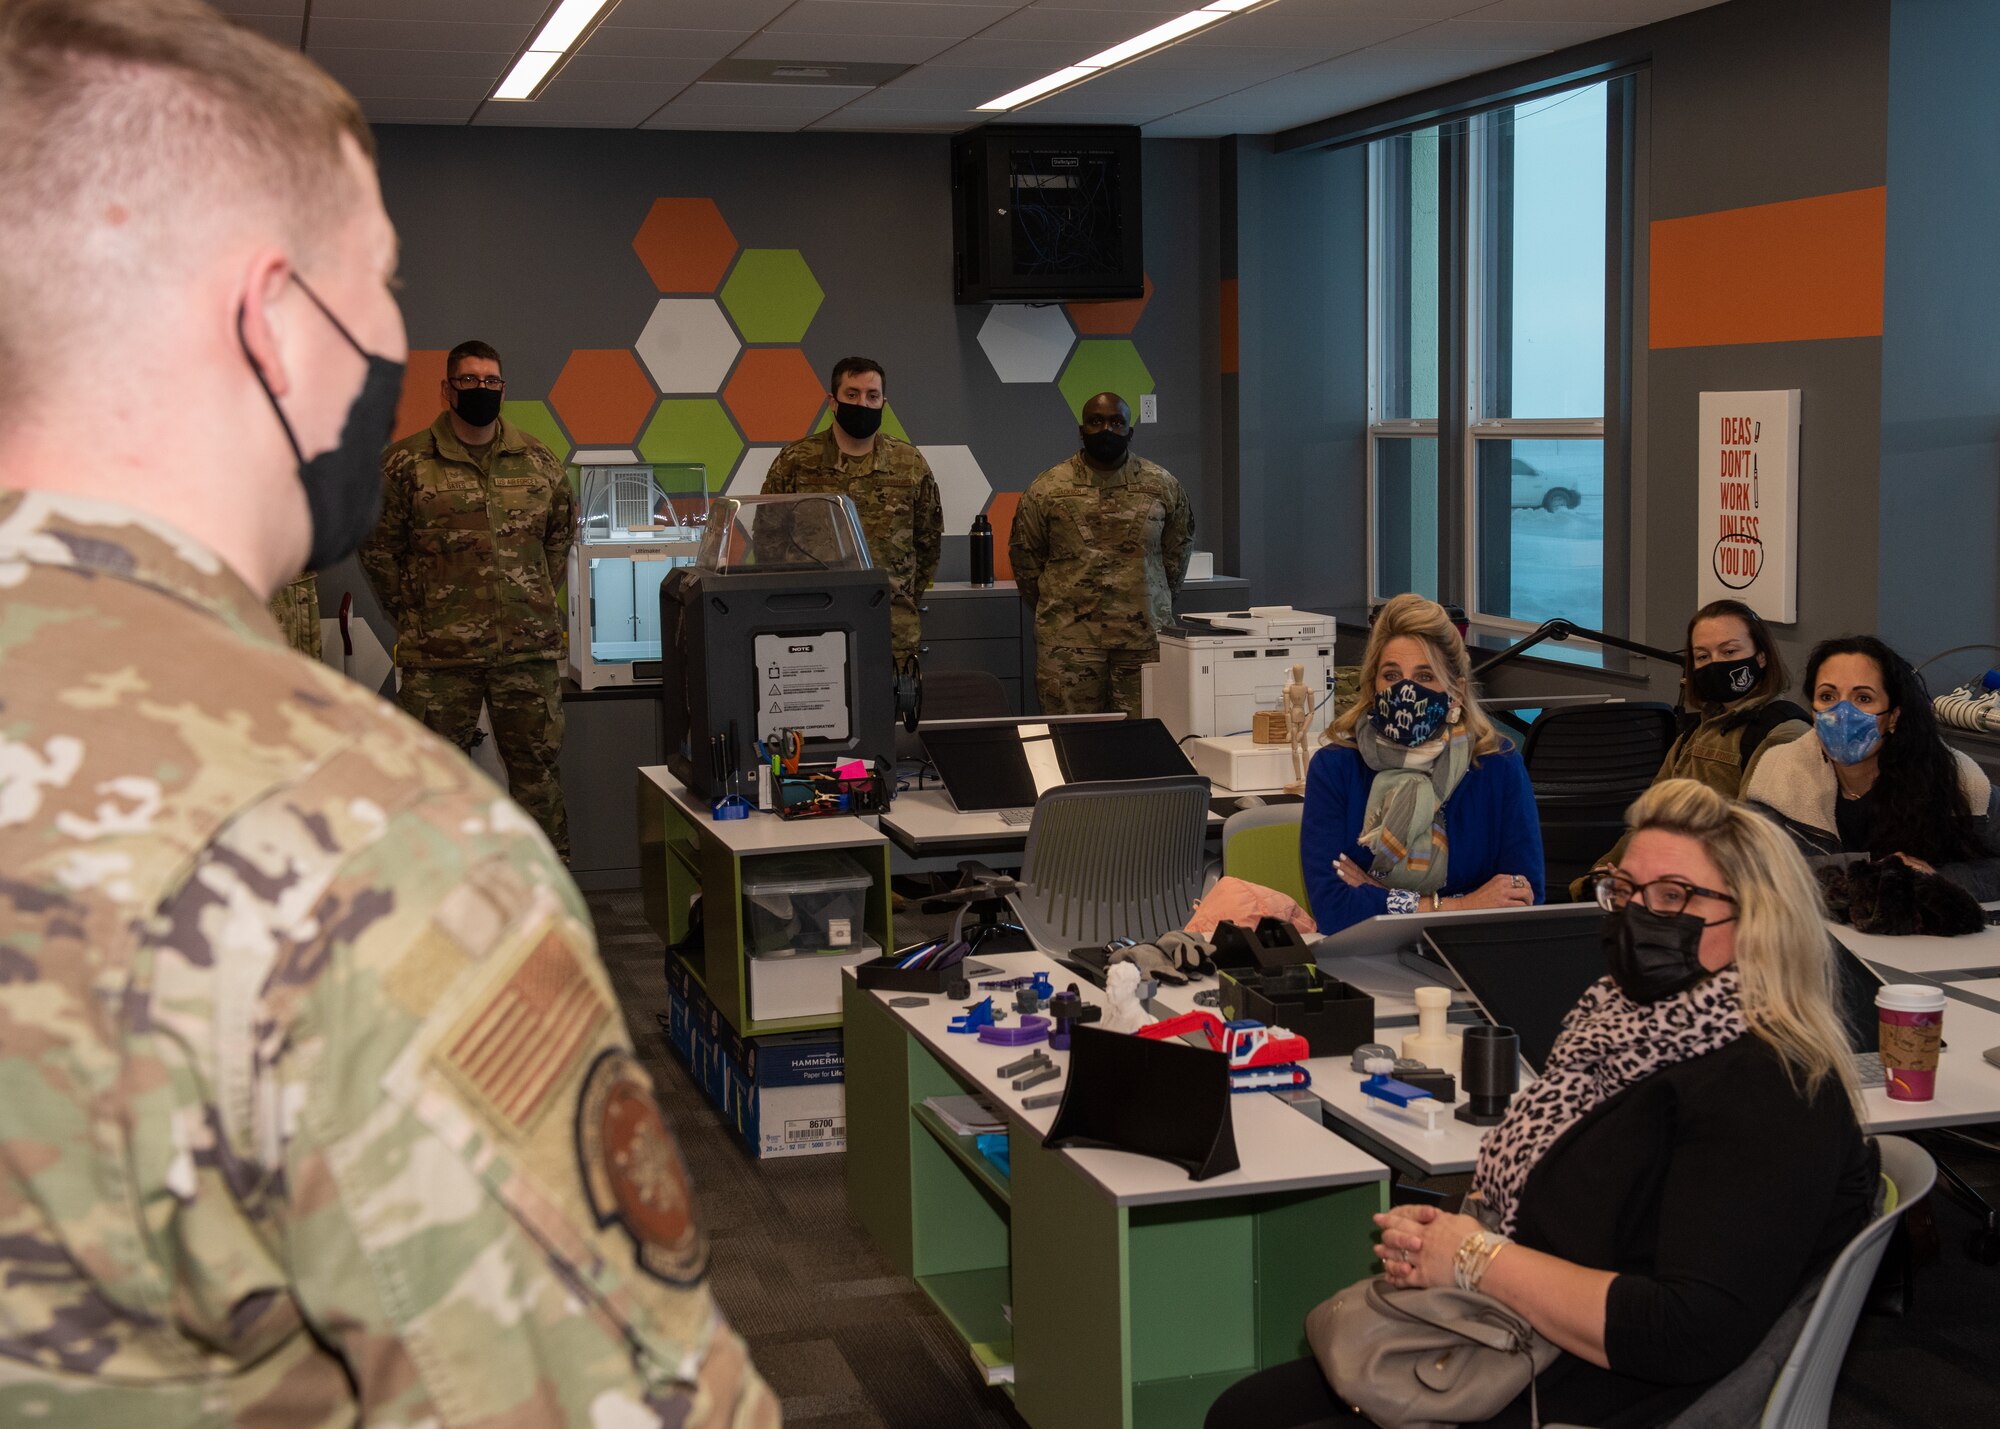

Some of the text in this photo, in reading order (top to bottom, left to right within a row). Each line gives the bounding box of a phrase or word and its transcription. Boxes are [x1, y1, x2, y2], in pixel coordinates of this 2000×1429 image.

[1721, 416, 1752, 445] IDEAS
[1720, 449, 1751, 478] DON'T
[1720, 482, 1751, 511] WORK
[1719, 514, 1759, 544] UNLESS
[1719, 546, 1739, 576] YOU
[809, 1119, 833, 1129] 86700
